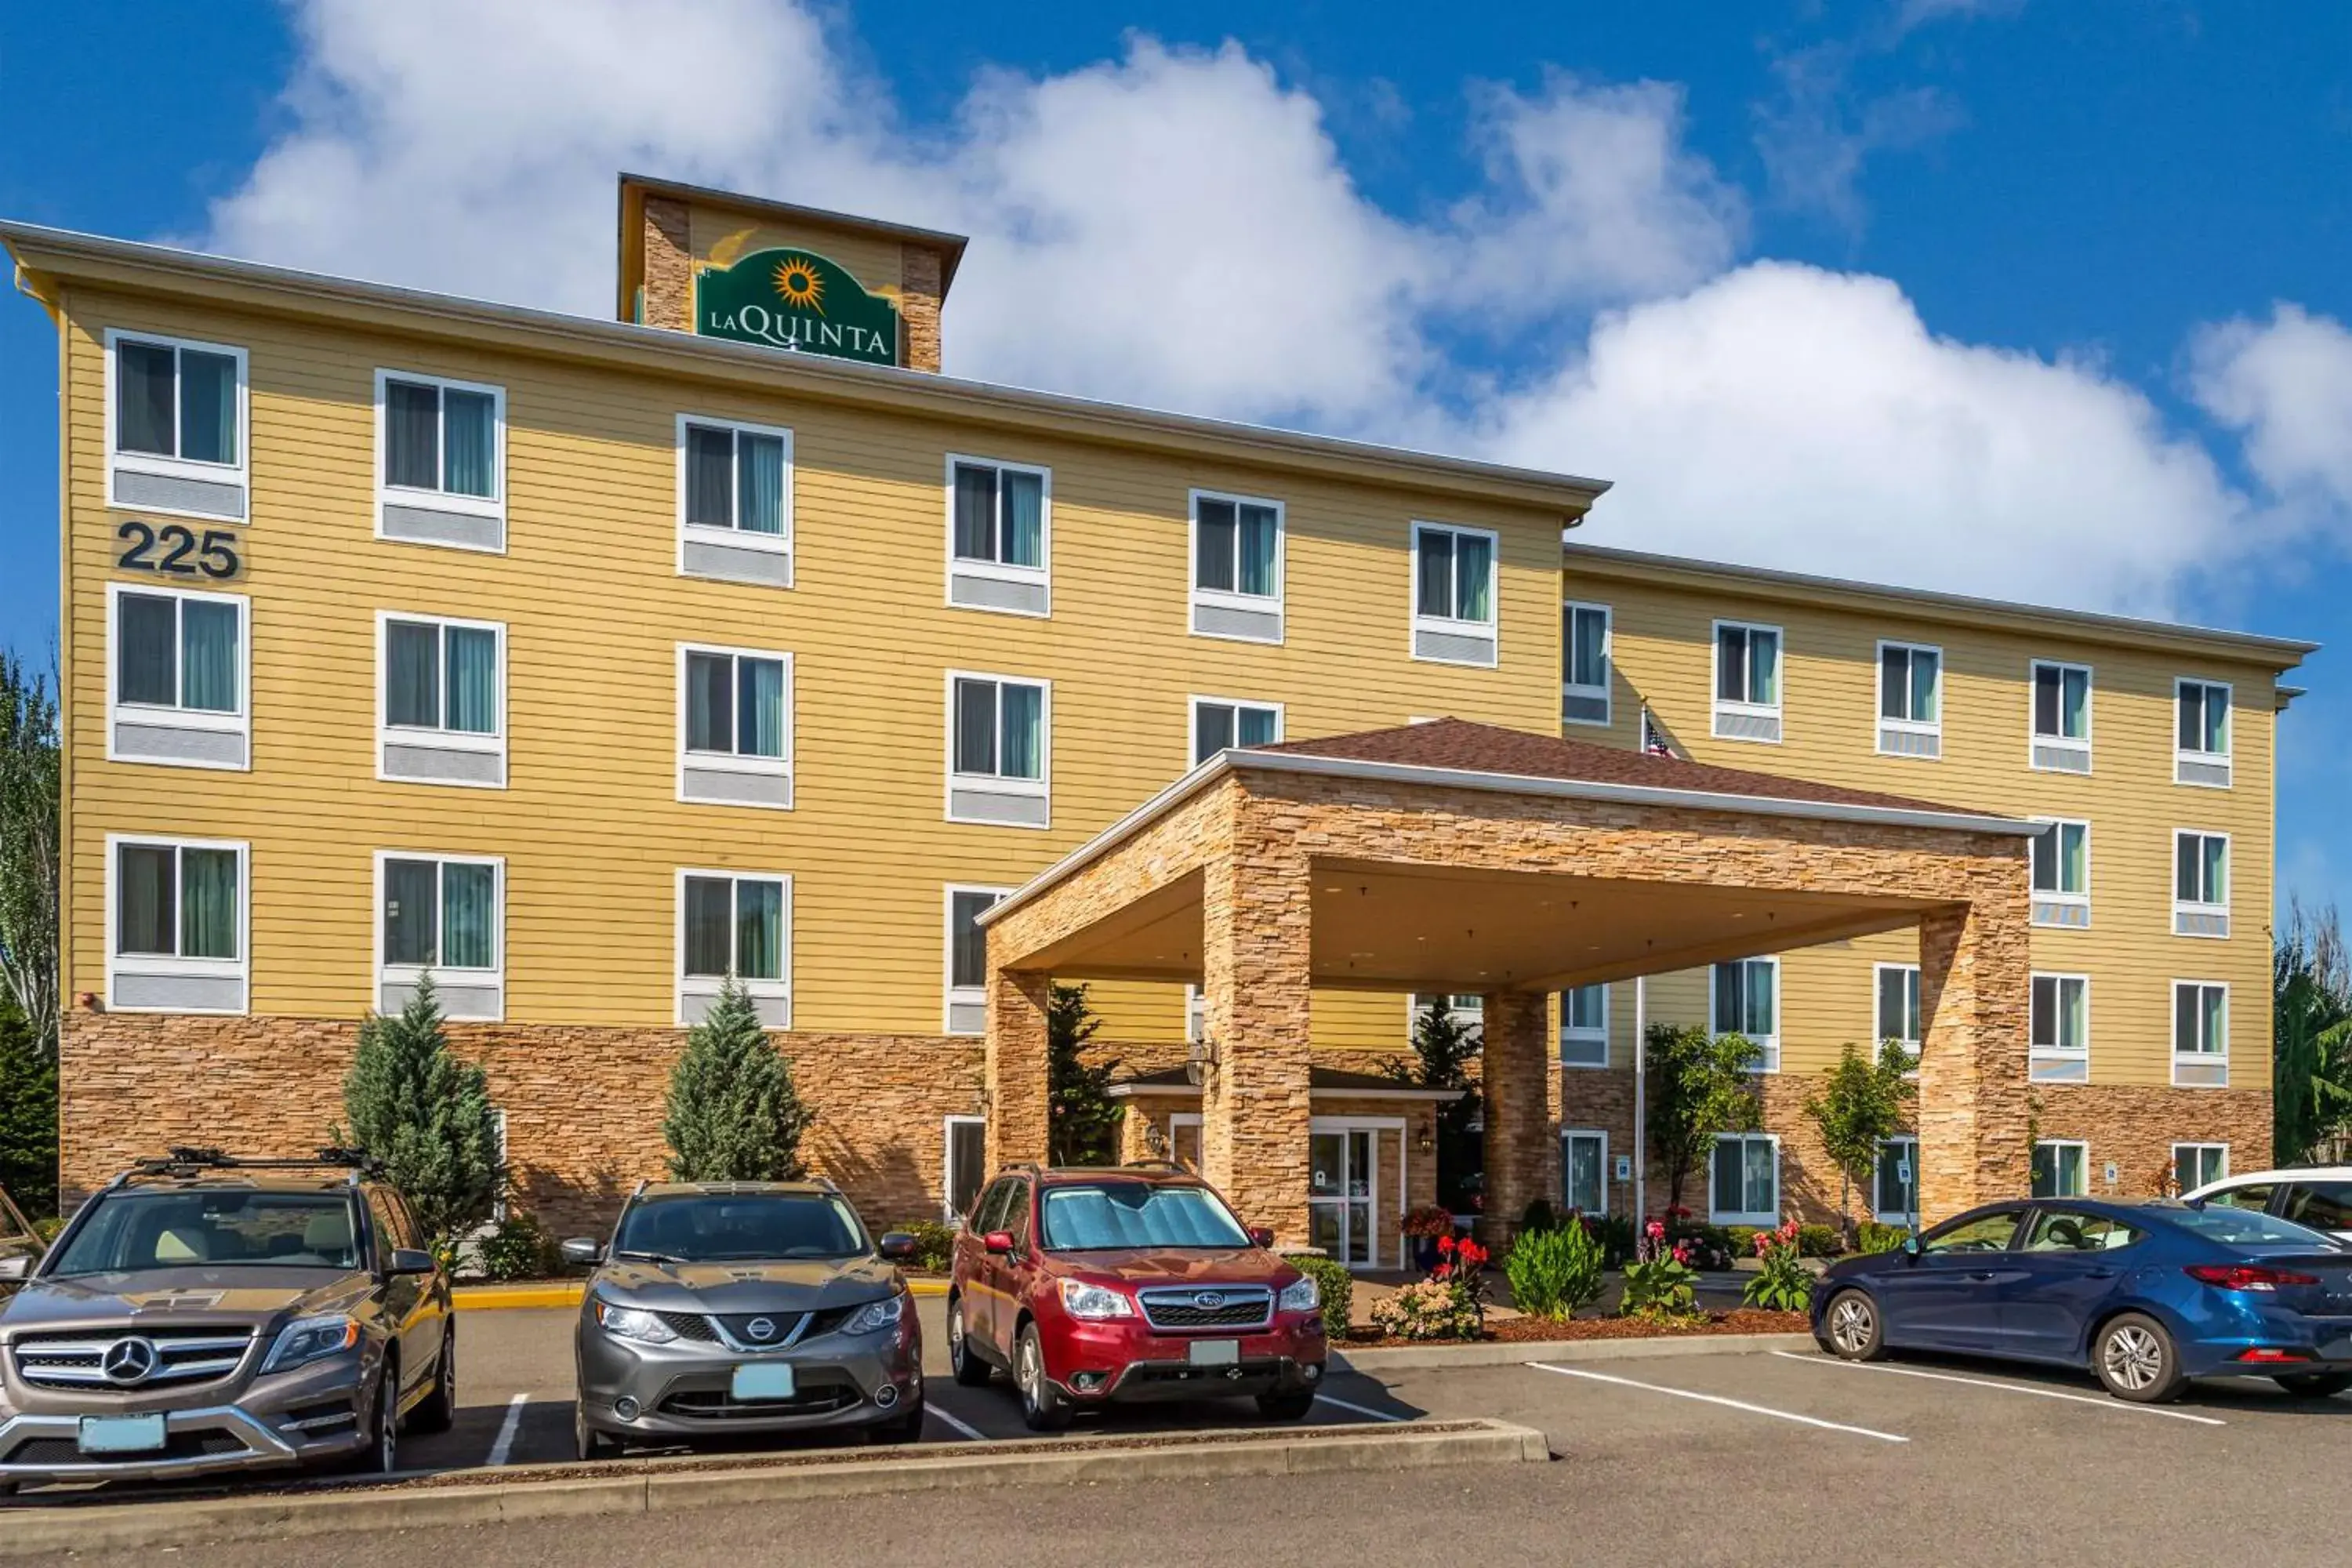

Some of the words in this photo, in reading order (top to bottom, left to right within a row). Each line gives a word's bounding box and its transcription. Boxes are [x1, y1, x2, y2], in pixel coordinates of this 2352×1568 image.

[710, 311, 738, 331] LA
[739, 305, 890, 355] QUINTA
[118, 521, 238, 578] 225
